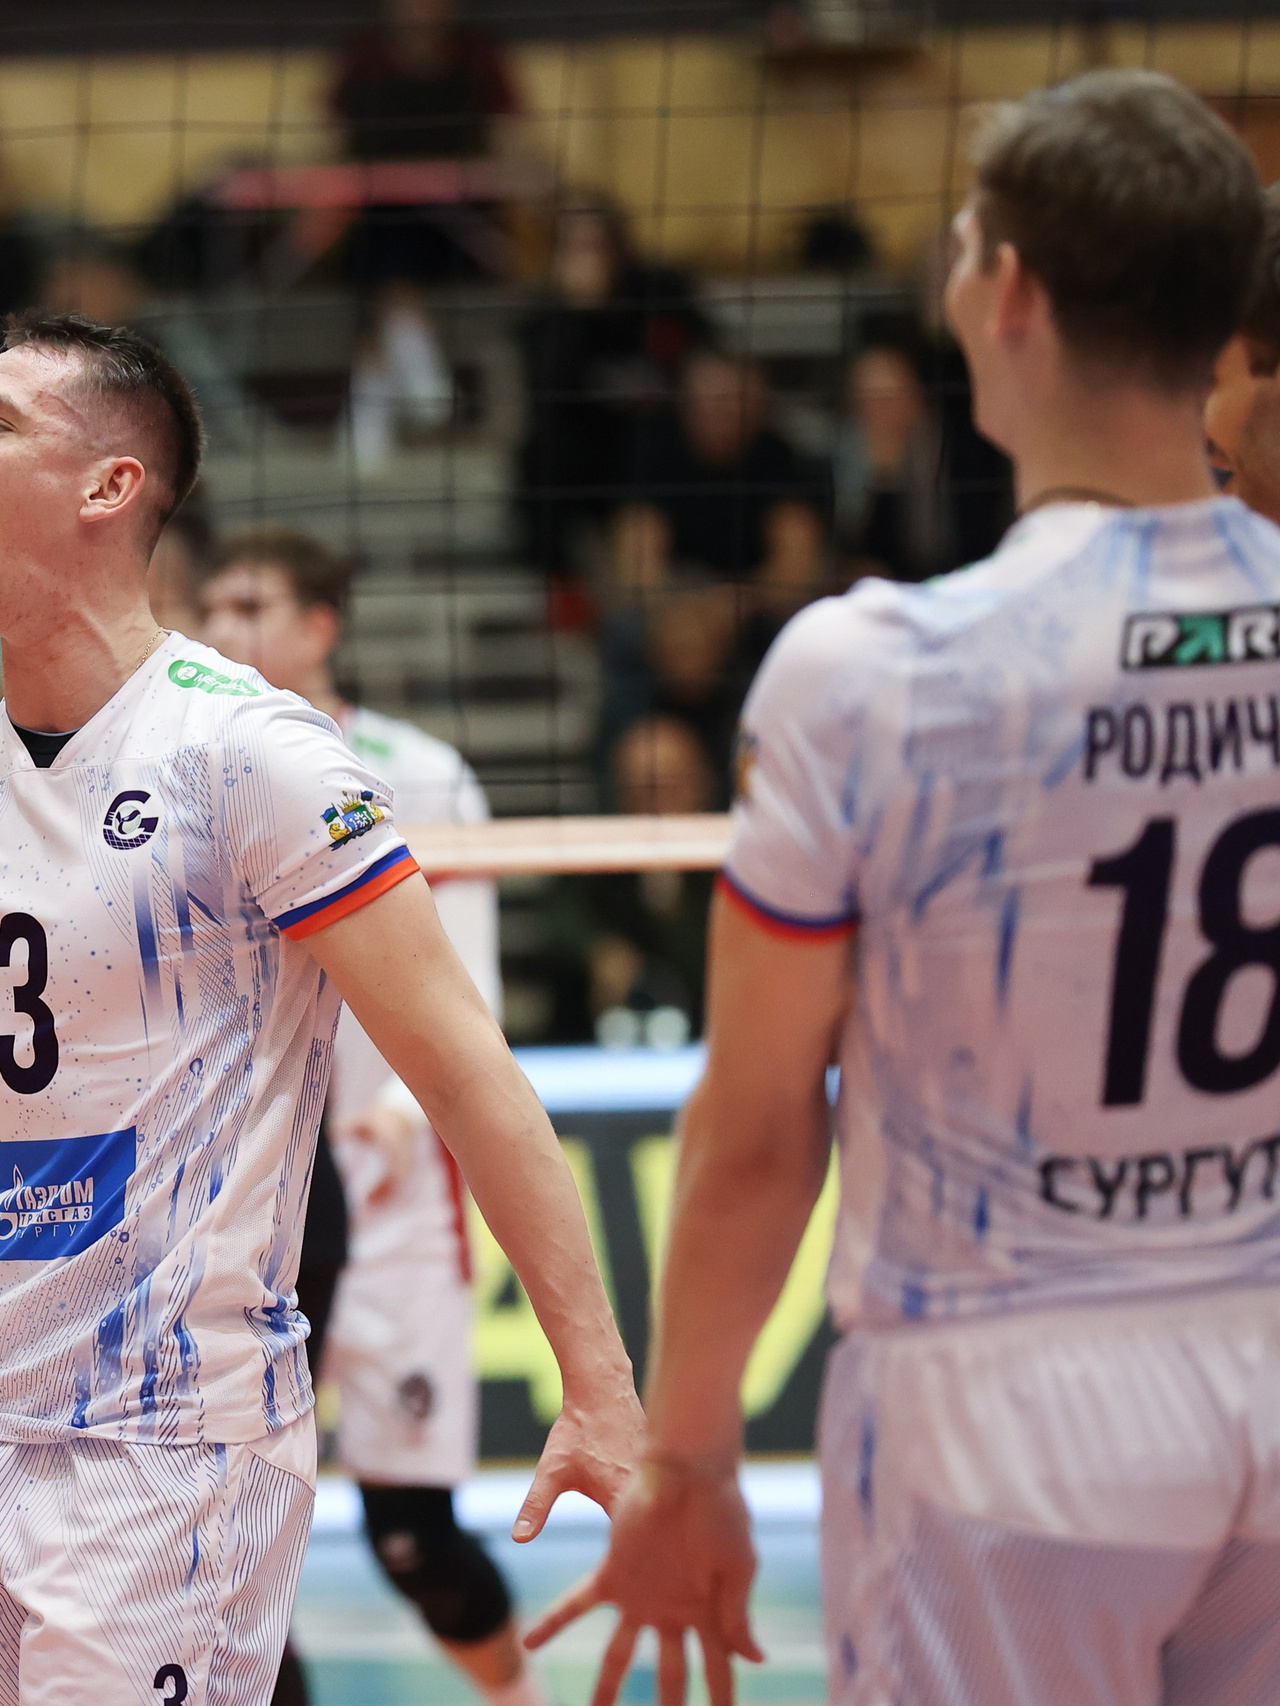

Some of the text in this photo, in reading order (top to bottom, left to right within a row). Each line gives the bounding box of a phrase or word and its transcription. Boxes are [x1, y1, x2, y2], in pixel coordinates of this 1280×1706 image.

[1084, 695, 1280, 779] РОДИЧ
[1086, 806, 1280, 1108] 18
[153, 1664, 188, 1706] 3
